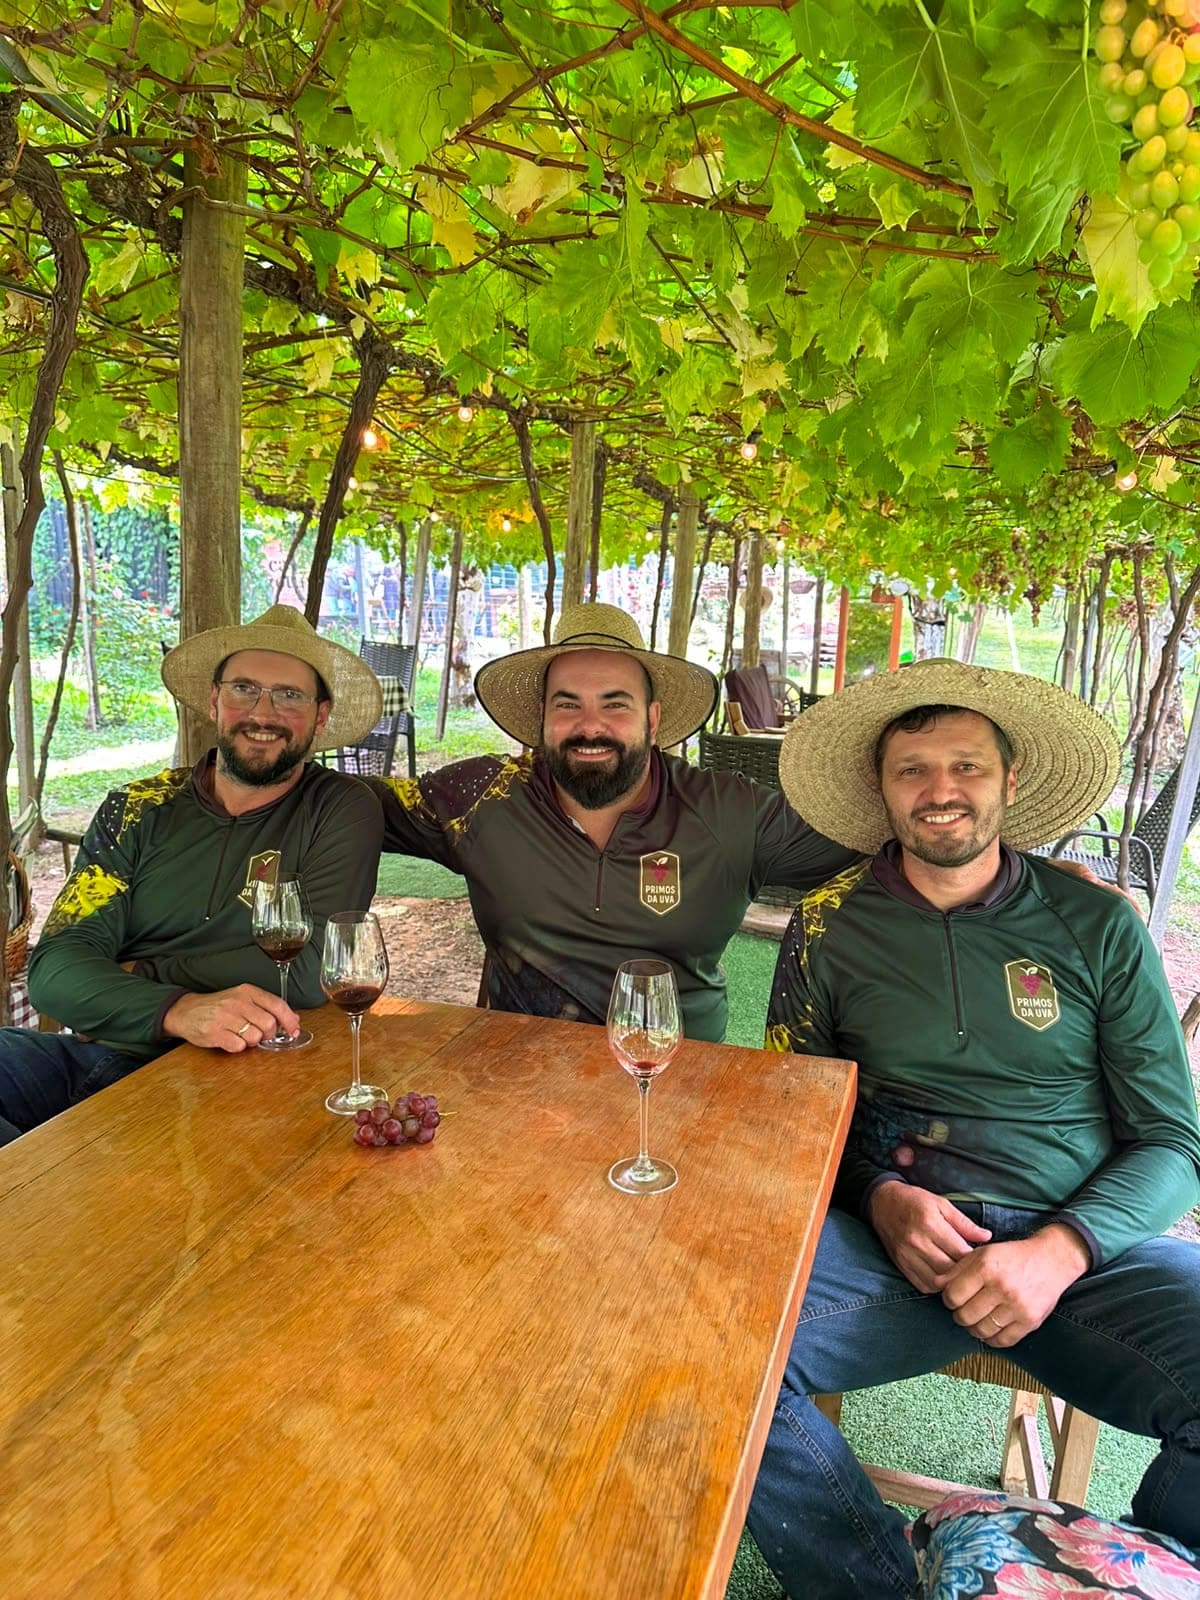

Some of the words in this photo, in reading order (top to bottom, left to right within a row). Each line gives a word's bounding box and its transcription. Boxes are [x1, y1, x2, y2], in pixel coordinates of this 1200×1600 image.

[241, 888, 252, 896] DA
[645, 885, 676, 894] PRIMOS
[647, 895, 658, 903] DA
[659, 895, 675, 903] UVA
[1016, 997, 1053, 1008] PRIMOS
[1021, 1007, 1034, 1017] DA
[1035, 1008, 1054, 1018] UVA
